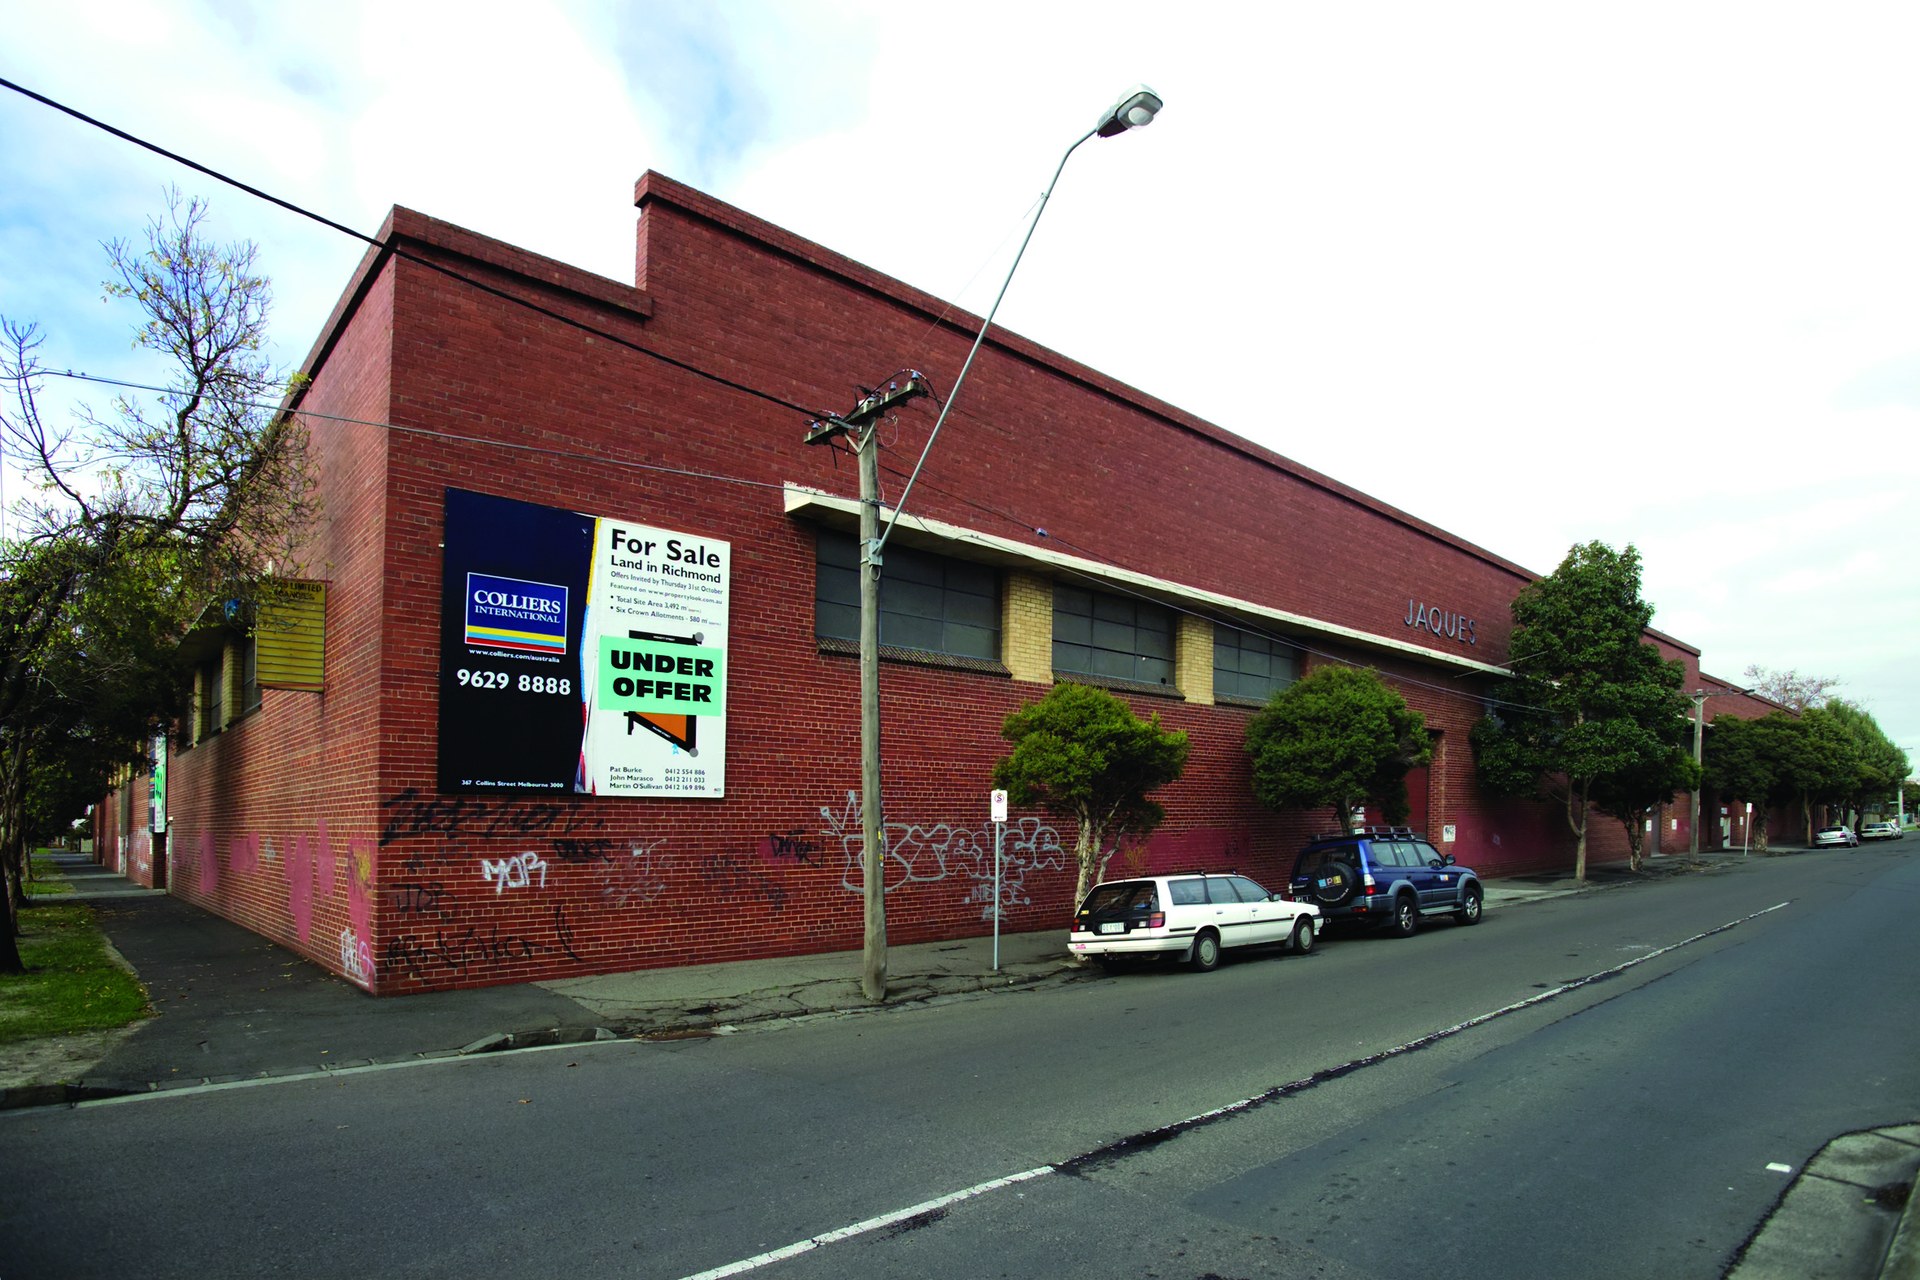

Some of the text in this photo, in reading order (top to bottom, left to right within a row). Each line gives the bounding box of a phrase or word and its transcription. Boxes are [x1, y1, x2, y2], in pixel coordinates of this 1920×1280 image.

[611, 528, 720, 568] For Sale
[611, 555, 721, 583] Land in Richmond
[610, 571, 629, 580] Offers
[630, 573, 651, 583] Invited
[661, 578, 687, 590] Thursday
[701, 585, 723, 595] October
[610, 582, 637, 592] Featured
[648, 588, 722, 604] www.propertylook.com.au
[474, 590, 561, 614] COLLIERS
[616, 595, 632, 604] Total
[647, 600, 663, 608] Area
[475, 605, 561, 624] INTERNATIONAL
[627, 608, 649, 616] Crown
[650, 611, 684, 621] Allotments
[1404, 599, 1476, 645] JAQUES
[469, 649, 560, 663] www.colliers.com/australia
[611, 649, 714, 678] UNDER
[457, 668, 571, 695] 9629 8888
[613, 677, 712, 703] OFFER
